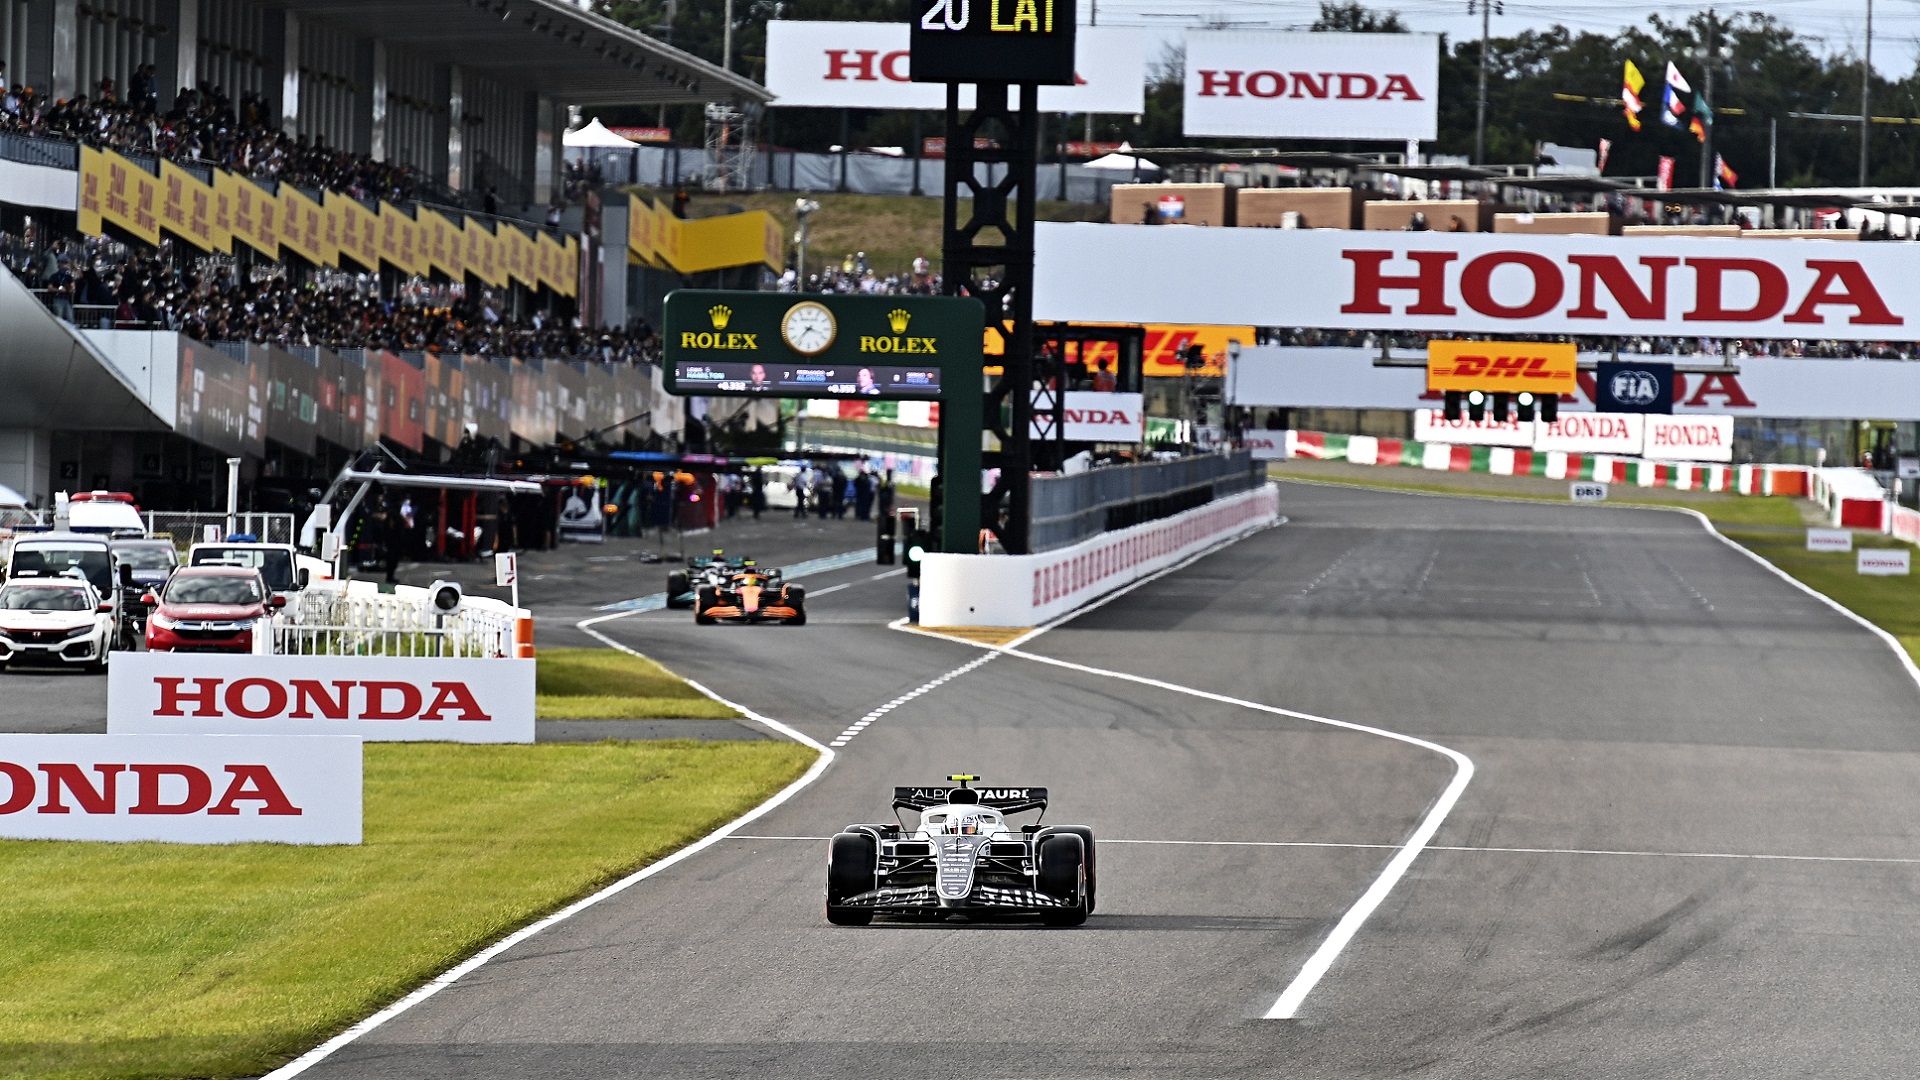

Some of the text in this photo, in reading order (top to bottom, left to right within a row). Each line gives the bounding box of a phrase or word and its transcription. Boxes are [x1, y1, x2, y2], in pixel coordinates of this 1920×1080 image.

[921, 0, 970, 30] 20
[1199, 71, 1422, 101] HONDA
[1341, 249, 1904, 325] HONDA
[681, 332, 758, 350] ROLEX
[860, 336, 937, 354] ROLEX
[1452, 355, 1553, 378] DHL
[1547, 415, 1630, 440] HONDA
[1654, 424, 1721, 447] HONDA
[153, 676, 492, 721] HONDA
